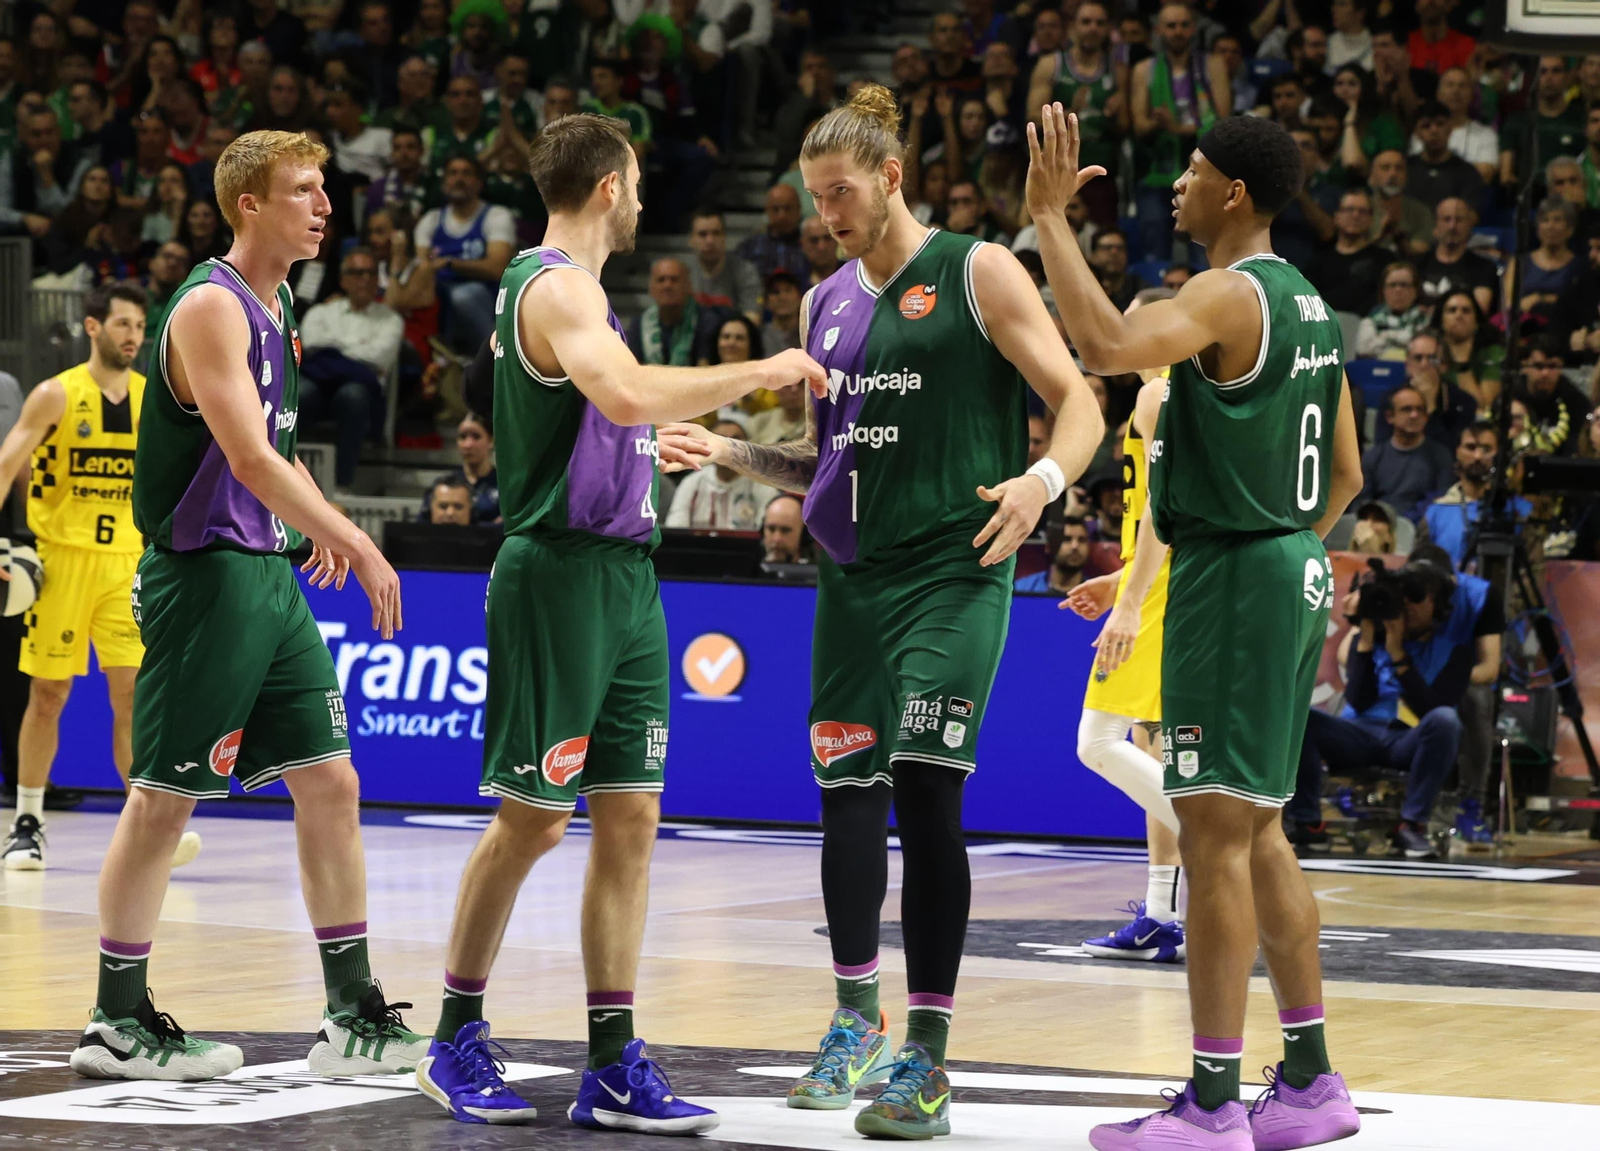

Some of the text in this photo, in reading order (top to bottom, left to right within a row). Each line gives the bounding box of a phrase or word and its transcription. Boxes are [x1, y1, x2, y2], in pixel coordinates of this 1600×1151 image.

[845, 367, 922, 396] Unicaja
[71, 452, 135, 476] Lenov
[1297, 403, 1322, 511] 6
[72, 484, 133, 501] tenerif
[848, 470, 858, 522] 1
[95, 514, 116, 545] 6
[907, 695, 943, 717] má
[950, 704, 968, 714] acb
[329, 707, 348, 731] lag
[357, 705, 469, 738] Smart
[900, 709, 940, 734] laga
[1178, 732, 1196, 741] acb
[646, 736, 667, 764] lag
